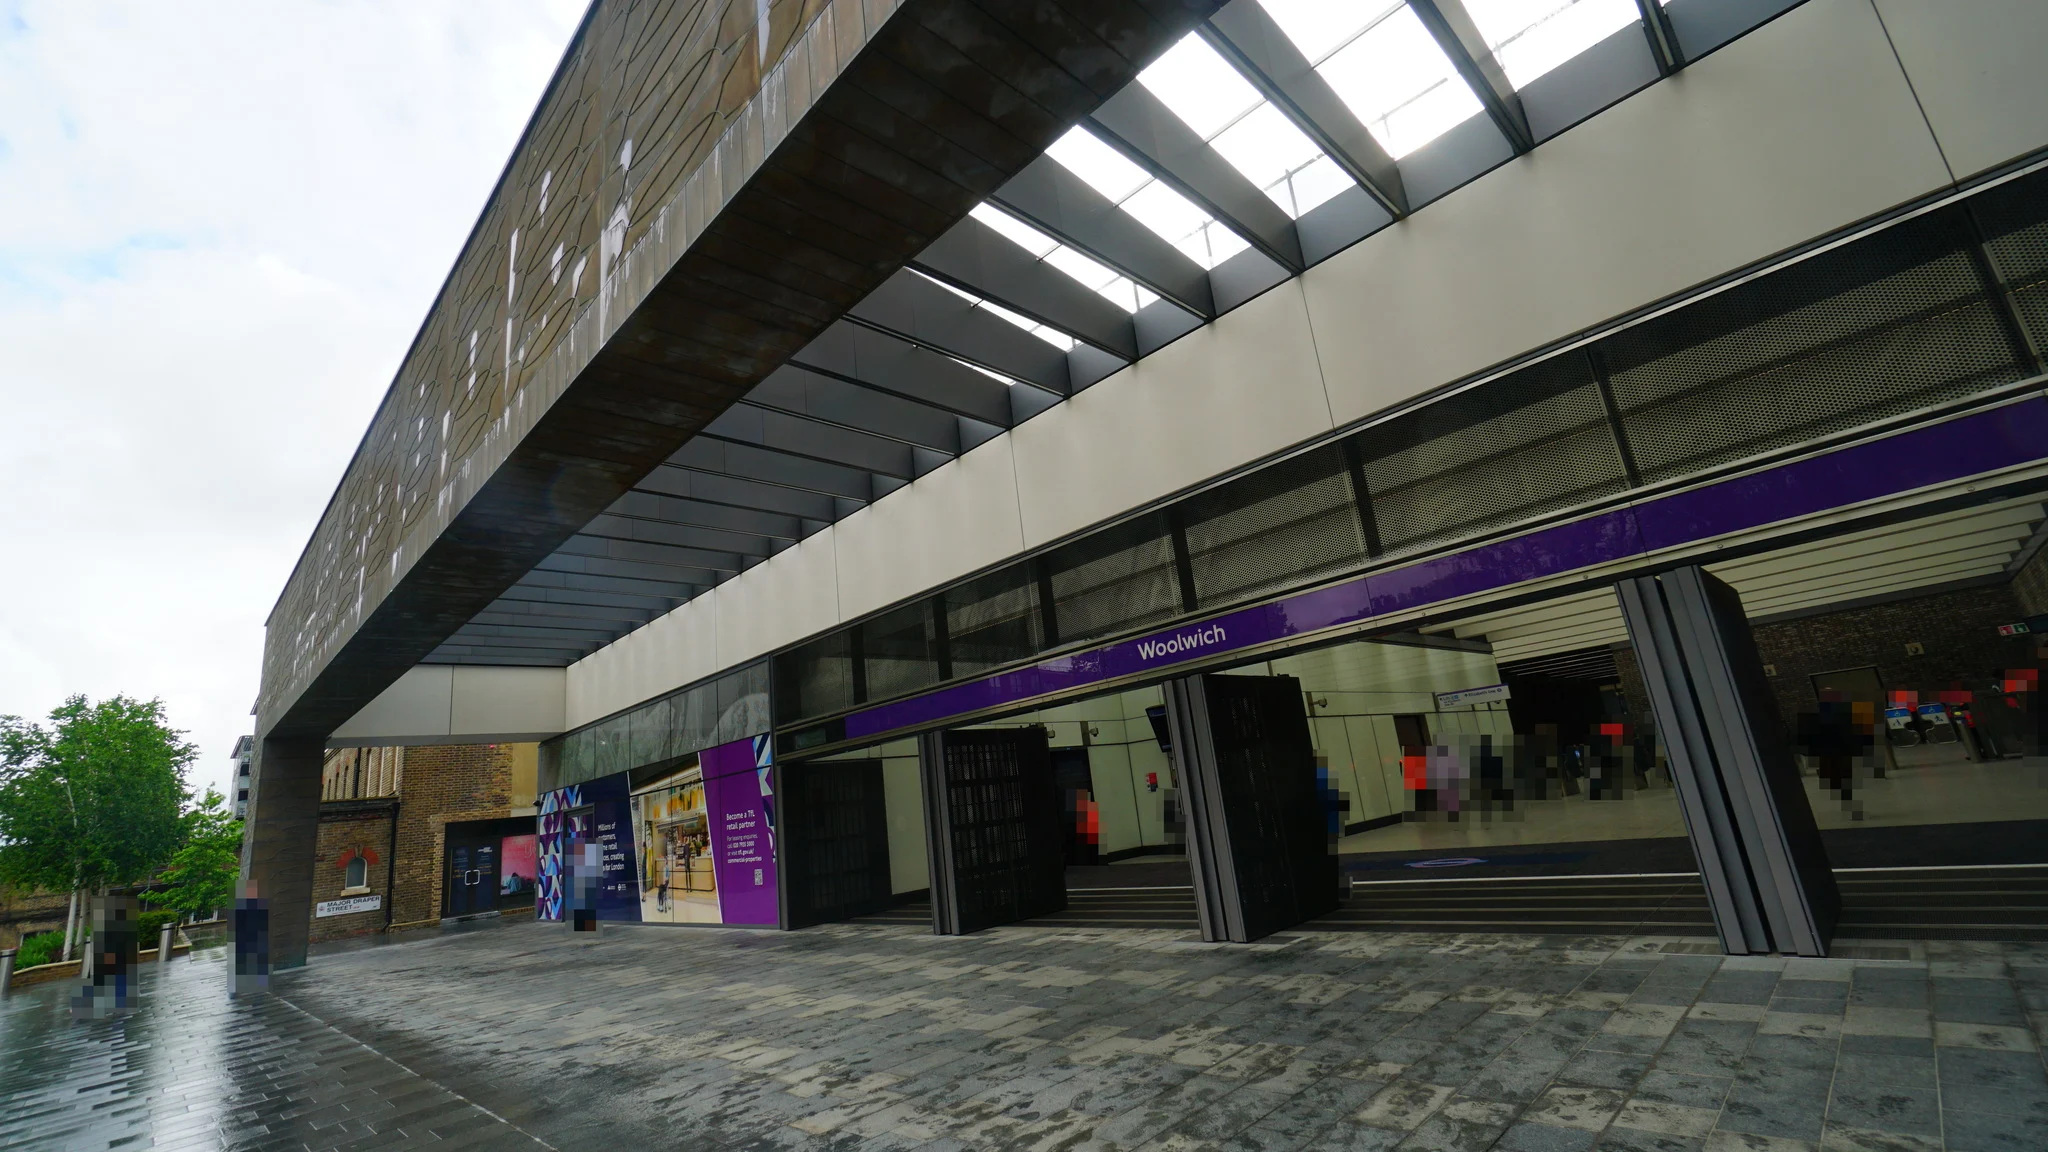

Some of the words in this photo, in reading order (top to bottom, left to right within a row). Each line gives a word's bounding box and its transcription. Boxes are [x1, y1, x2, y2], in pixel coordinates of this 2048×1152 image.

[1137, 624, 1226, 660] Woolwich
[726, 813, 743, 821] Become
[747, 810, 755, 818] TfL
[598, 823, 611, 831] Millions
[726, 822, 738, 830] retail
[738, 821, 755, 830] partner
[608, 842, 618, 850] retail
[610, 852, 624, 861] creating
[353, 896, 380, 904] DRAPER
